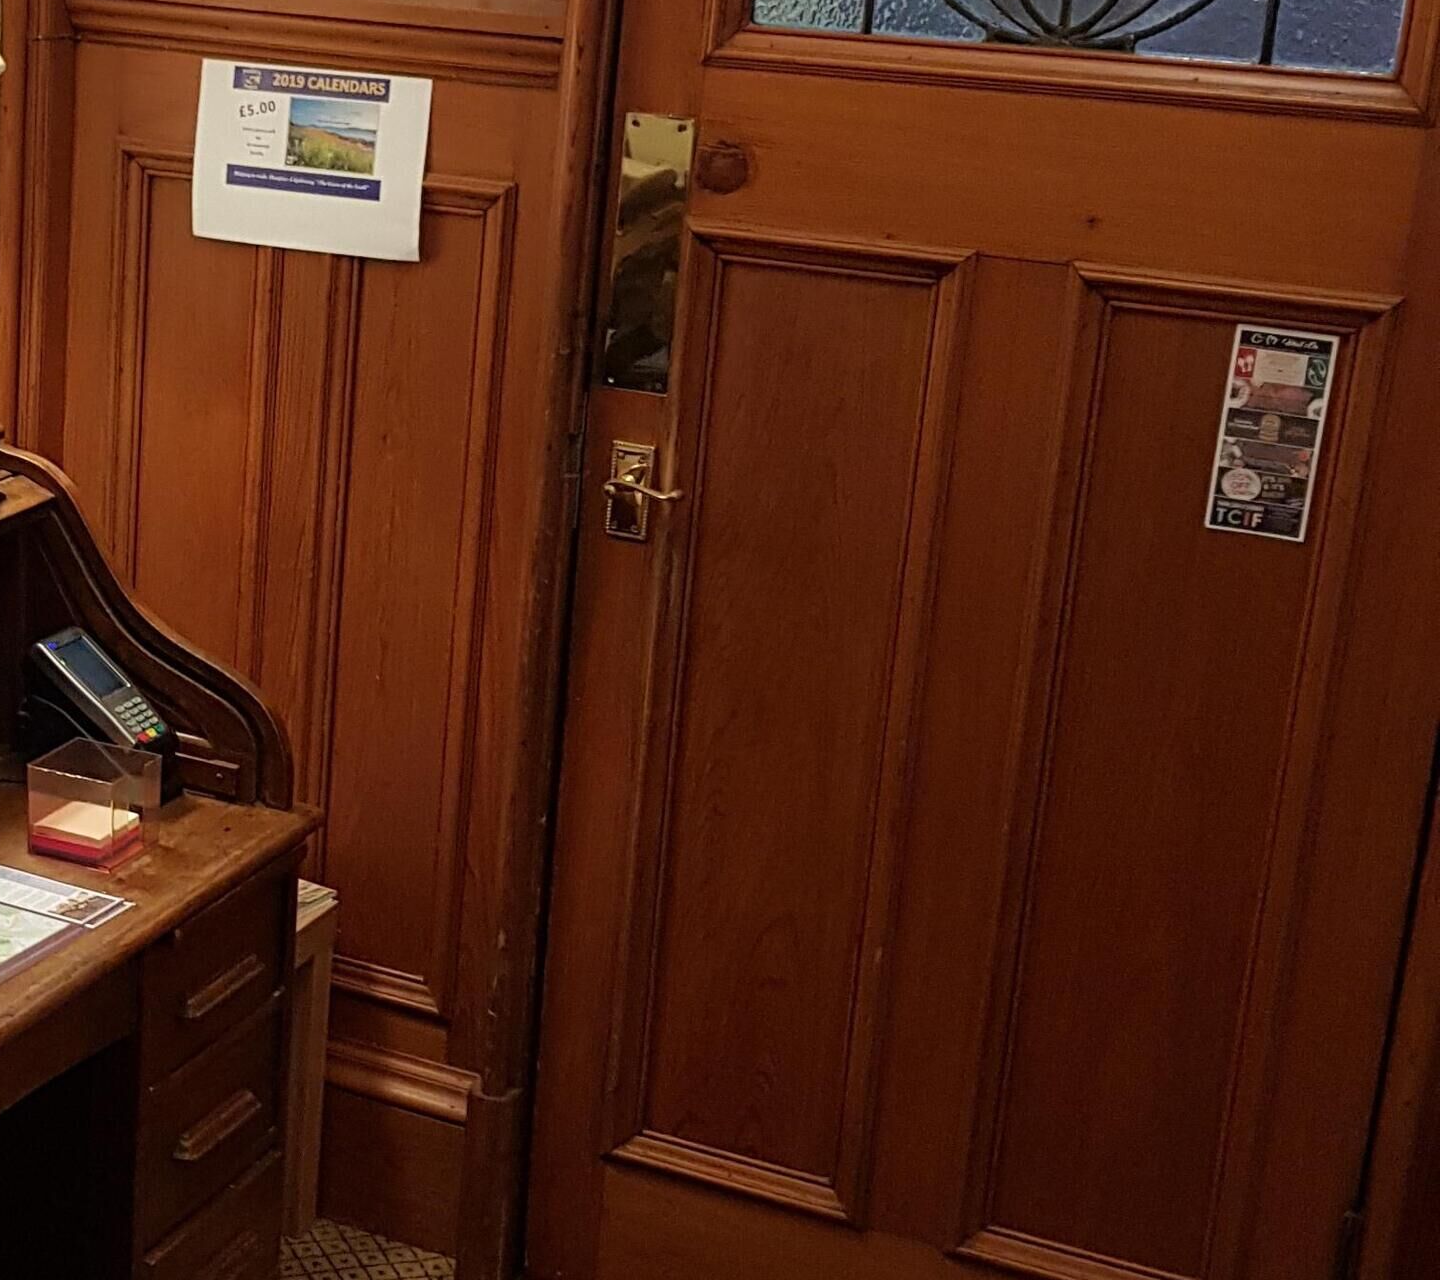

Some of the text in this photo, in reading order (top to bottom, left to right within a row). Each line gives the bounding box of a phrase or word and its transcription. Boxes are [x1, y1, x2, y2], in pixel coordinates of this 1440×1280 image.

[272, 73, 306, 89] 2019
[307, 76, 386, 97] CALENDARS
[239, 100, 277, 117] £5.00
